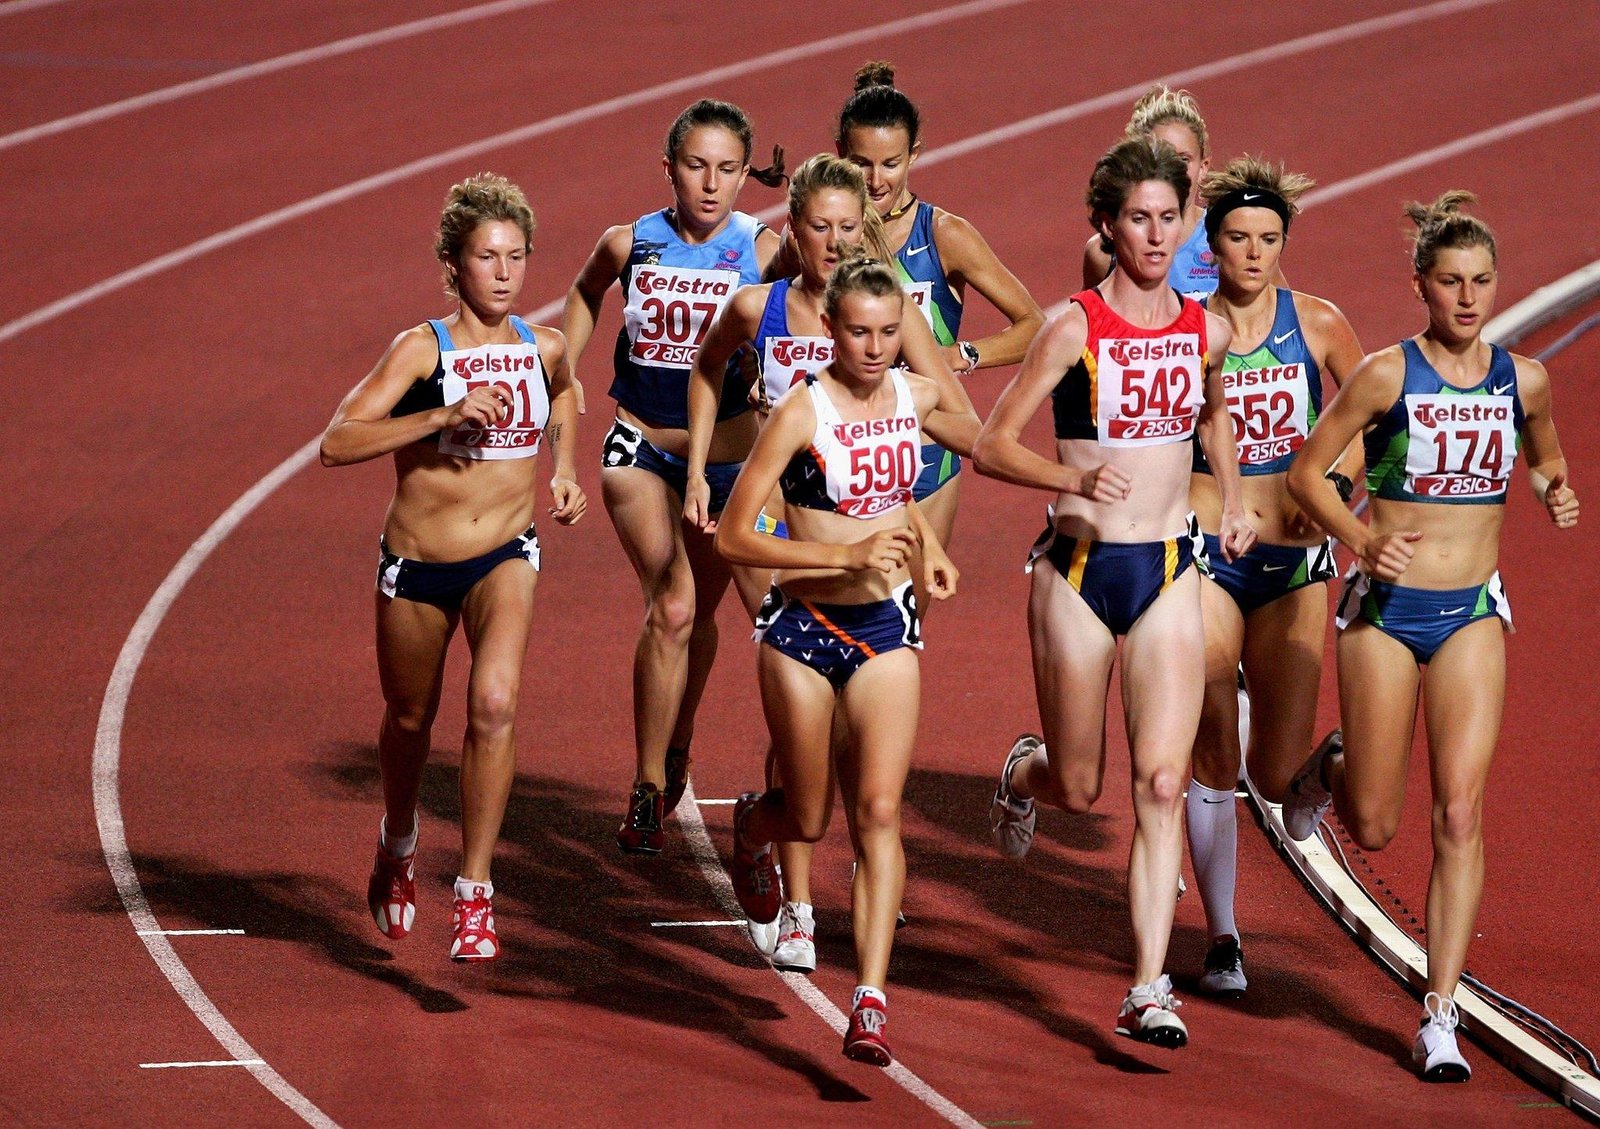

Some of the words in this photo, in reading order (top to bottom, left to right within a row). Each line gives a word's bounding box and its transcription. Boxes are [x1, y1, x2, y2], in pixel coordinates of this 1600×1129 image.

[635, 270, 730, 296] Telstra
[640, 297, 718, 345] 307
[1109, 339, 1194, 366] Telstra
[453, 353, 534, 379] Telstra
[1222, 364, 1298, 388] elstra
[1121, 366, 1192, 418] 542
[1143, 420, 1183, 436] asics
[1414, 403, 1507, 428] Telstra
[485, 431, 529, 447] asics
[834, 416, 916, 447] Telstra
[1248, 439, 1291, 461] asics
[1434, 430, 1502, 478] 174
[849, 440, 916, 496] 590
